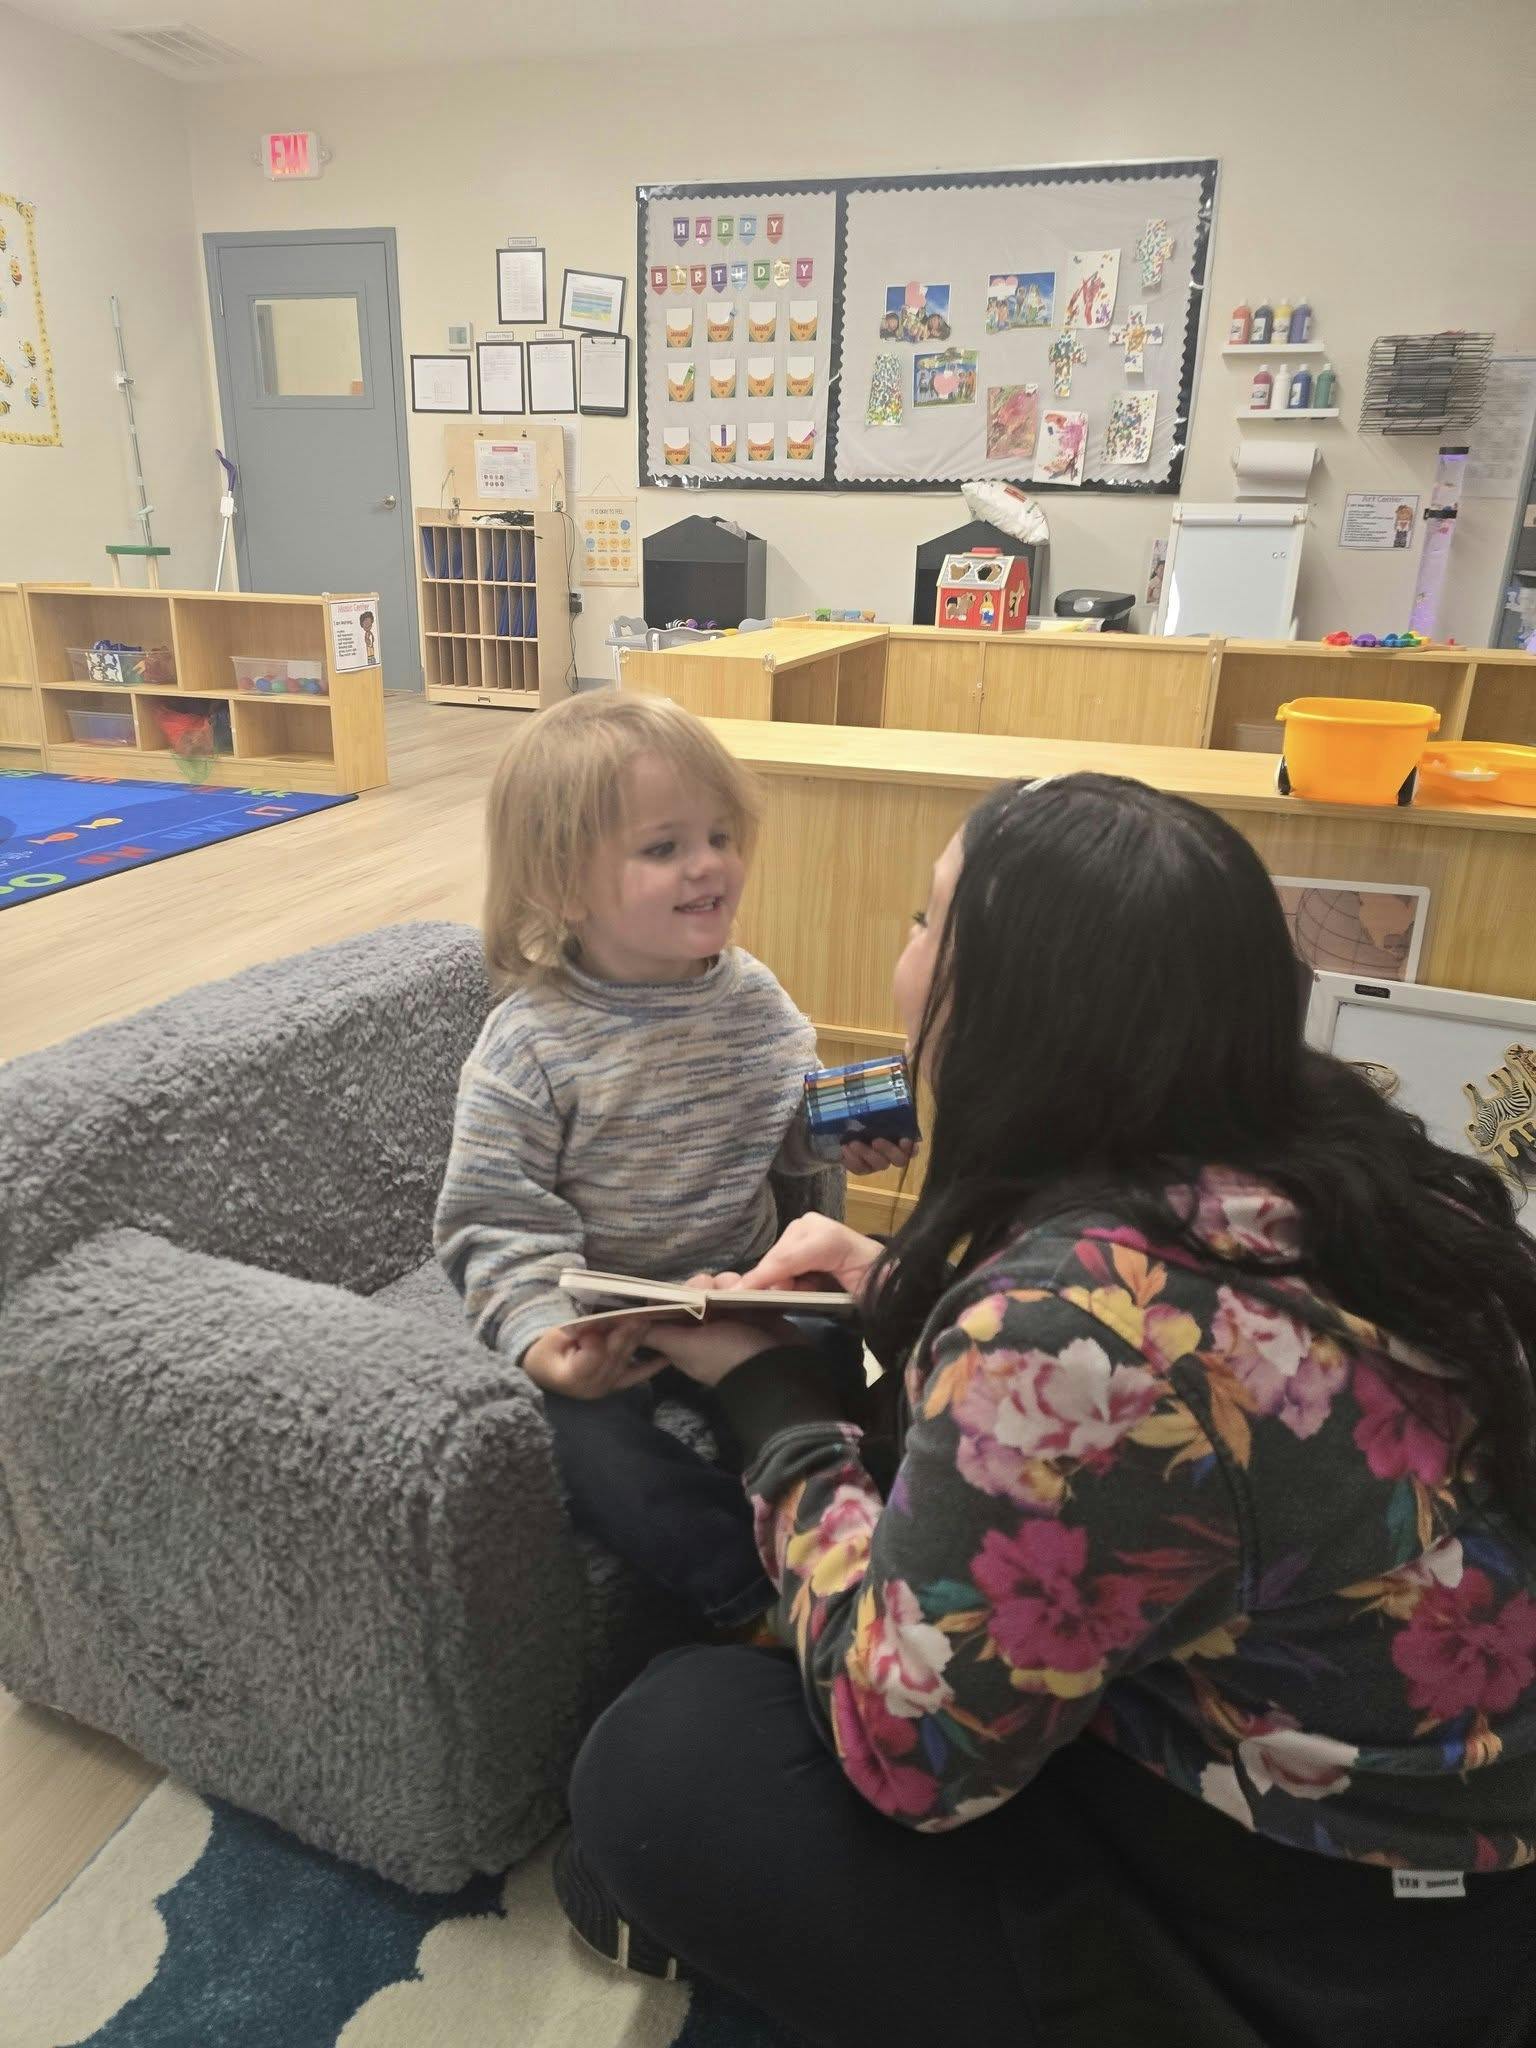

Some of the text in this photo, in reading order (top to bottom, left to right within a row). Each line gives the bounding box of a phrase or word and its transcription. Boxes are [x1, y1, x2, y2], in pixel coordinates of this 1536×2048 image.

[270, 134, 308, 173] EXIT
[677, 220, 779, 236] HAPPY
[655, 264, 809, 284] BIRTHDAY
